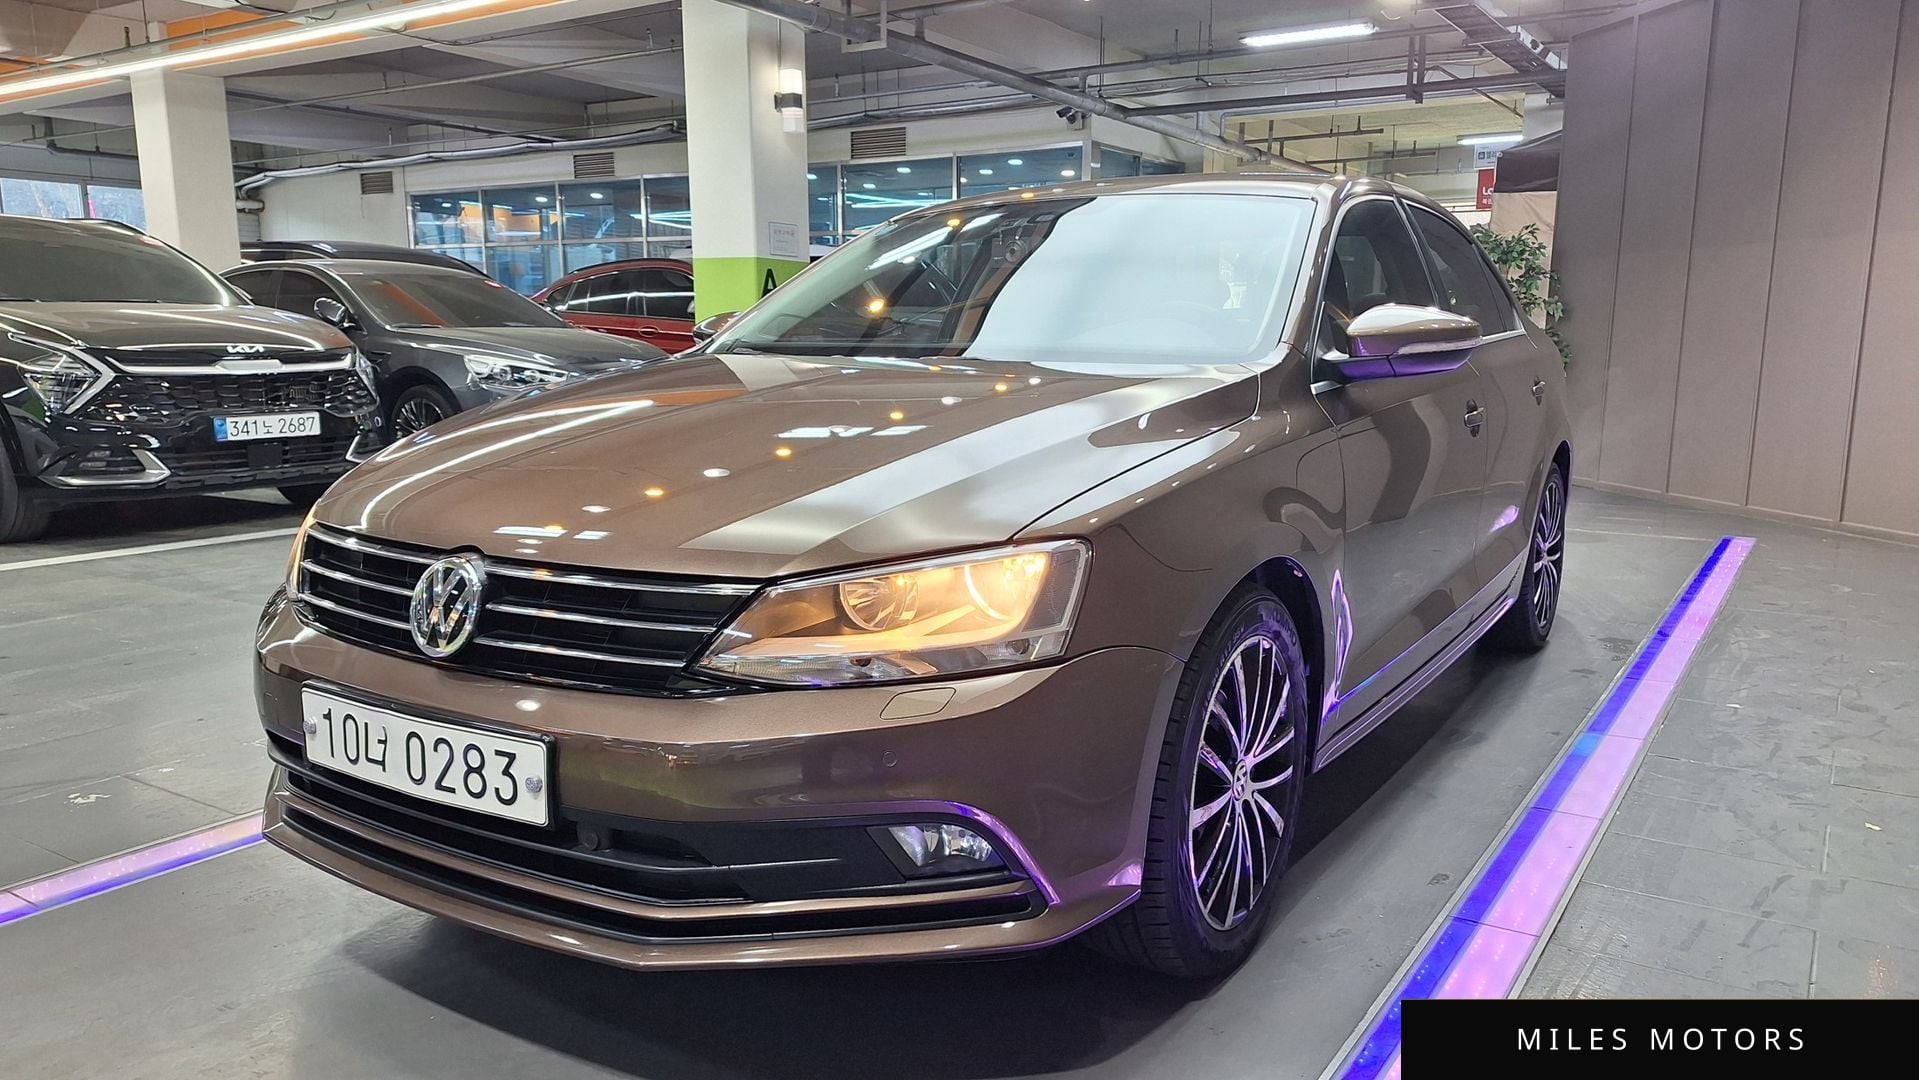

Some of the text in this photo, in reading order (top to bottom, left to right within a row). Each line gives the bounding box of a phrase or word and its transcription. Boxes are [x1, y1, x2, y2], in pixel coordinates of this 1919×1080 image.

[761, 268, 778, 298] A
[229, 416, 315, 437] 341노 2687
[322, 707, 519, 806] 10너 0283
